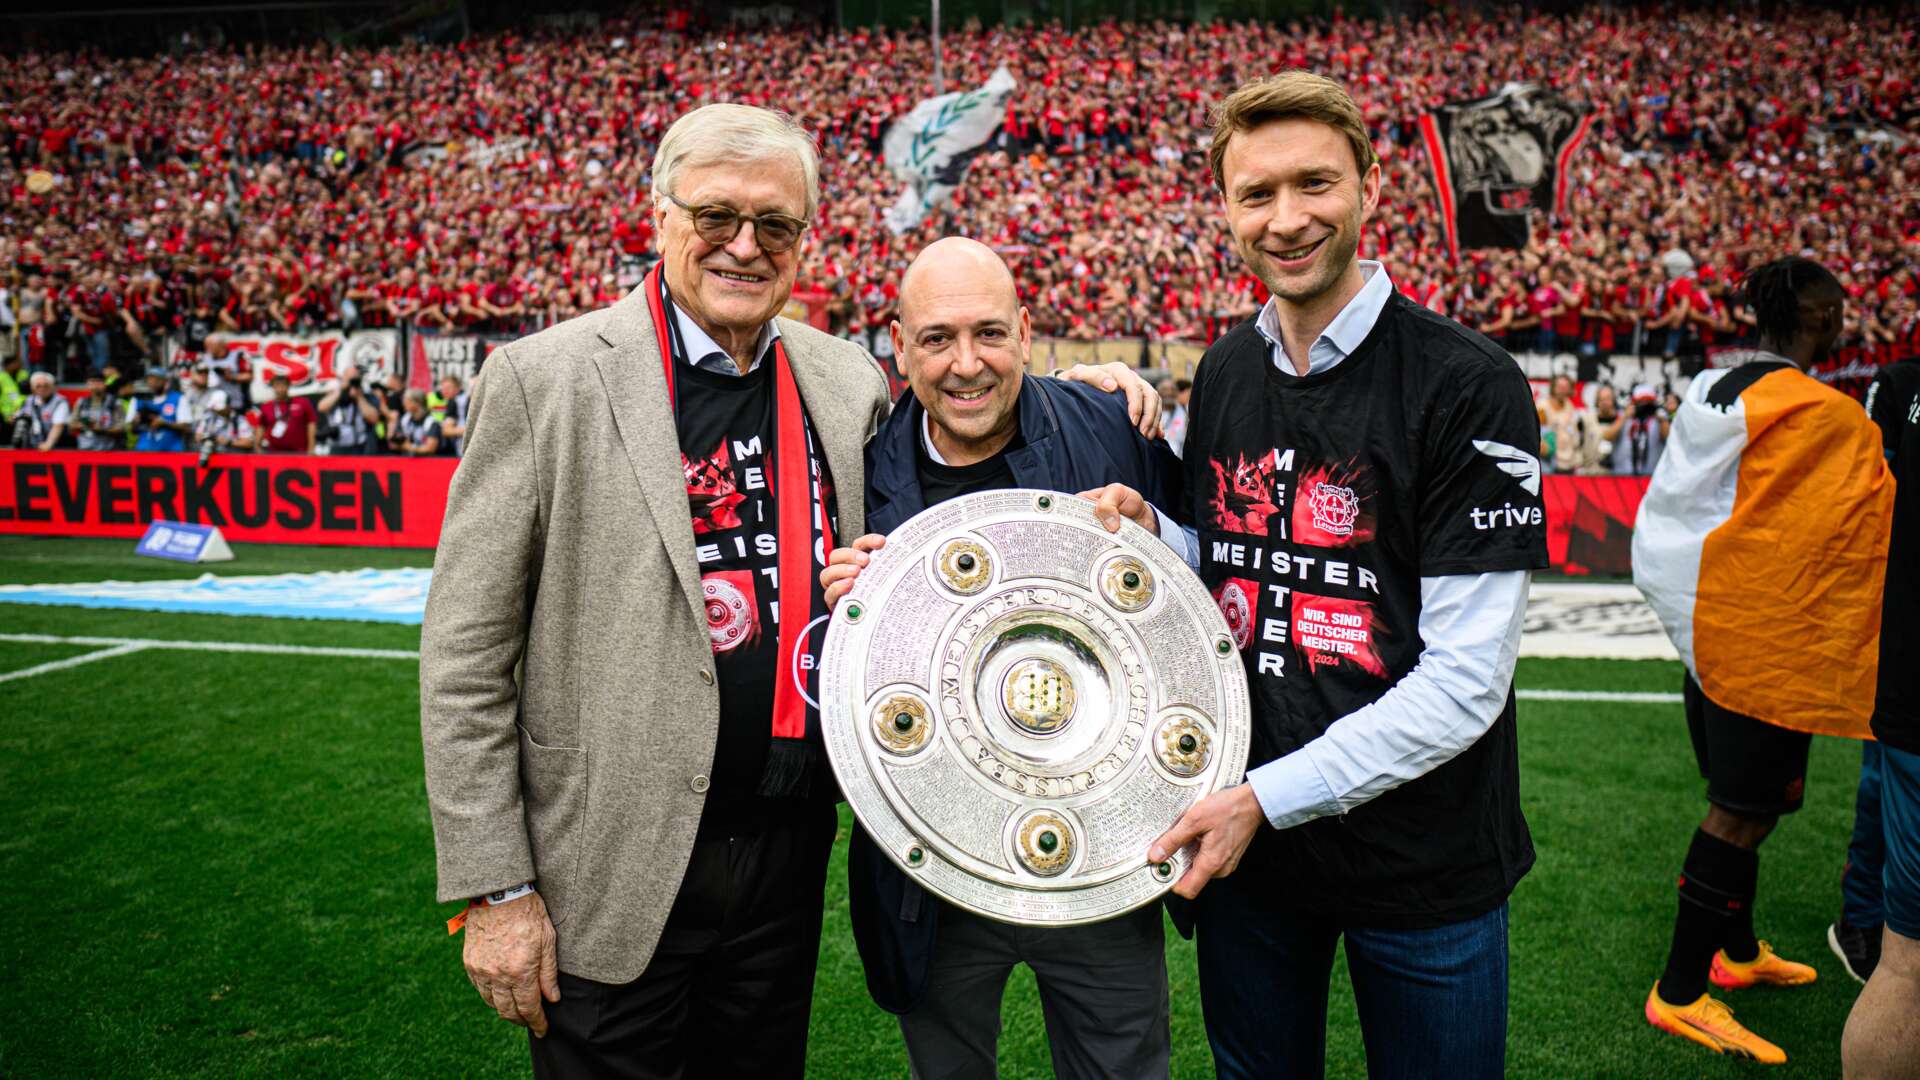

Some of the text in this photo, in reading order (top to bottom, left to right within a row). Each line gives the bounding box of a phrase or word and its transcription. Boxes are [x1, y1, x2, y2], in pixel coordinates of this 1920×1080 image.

[424, 336, 475, 360] WEST
[1470, 502, 1542, 531] trive
[1212, 541, 1380, 595] MEISTER
[1259, 449, 1295, 677] MEISTER
[1303, 607, 1362, 628] WIR. SIND
[1297, 619, 1368, 643] DEUTSCHER
[1301, 634, 1358, 655] MEISTER.
[1315, 654, 1340, 666] 2024
